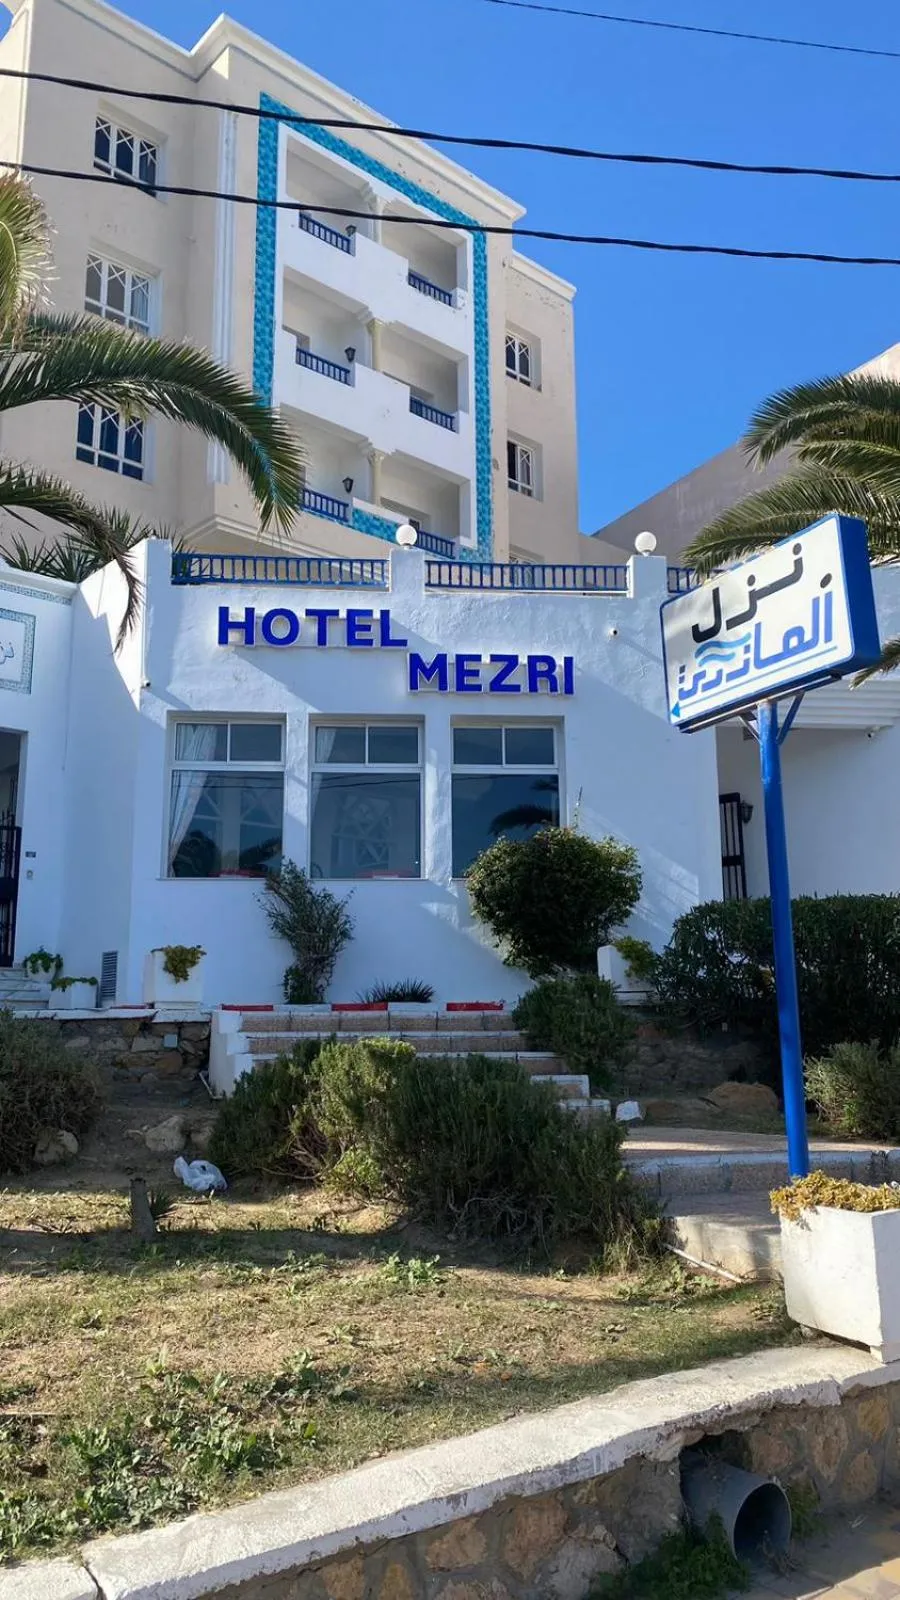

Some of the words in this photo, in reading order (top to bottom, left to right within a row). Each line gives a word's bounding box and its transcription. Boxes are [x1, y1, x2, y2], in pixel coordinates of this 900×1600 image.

[691, 543, 804, 643] نزل
[218, 607, 409, 648] HOTEL
[408, 653, 575, 695] MEZRI
